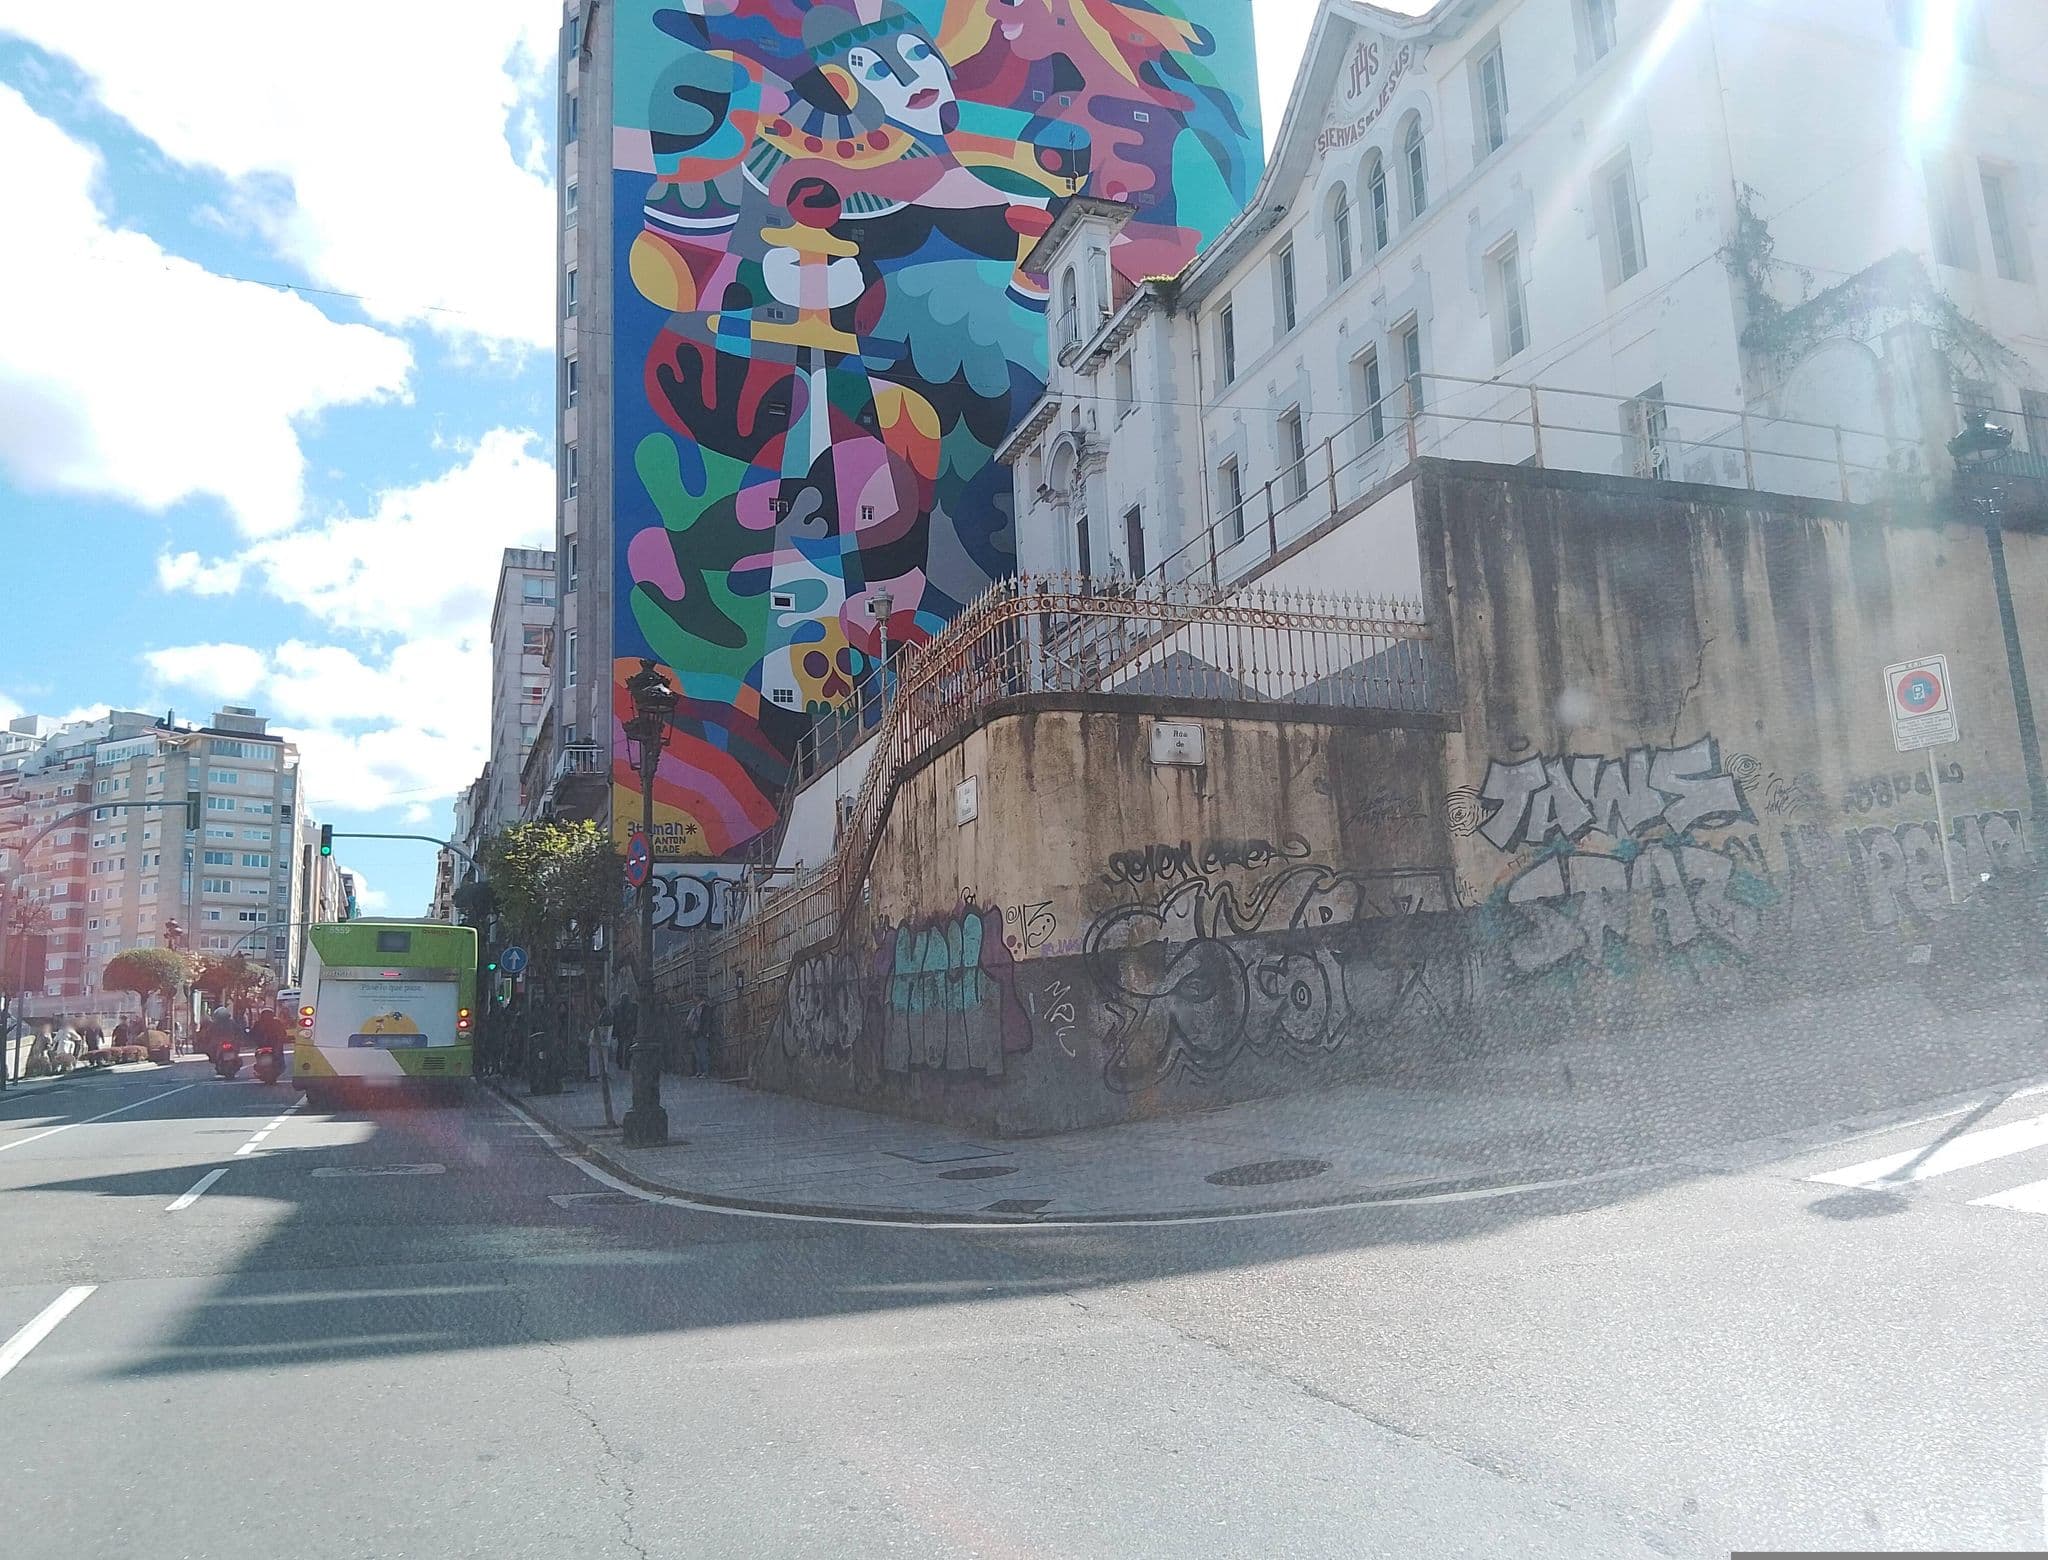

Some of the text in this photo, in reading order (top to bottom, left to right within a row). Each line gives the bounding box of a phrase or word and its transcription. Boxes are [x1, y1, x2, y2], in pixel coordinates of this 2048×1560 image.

[1317, 117, 1366, 153] SIERVAS
[1375, 45, 1409, 117] JESUS
[654, 836, 686, 845] ANTON
